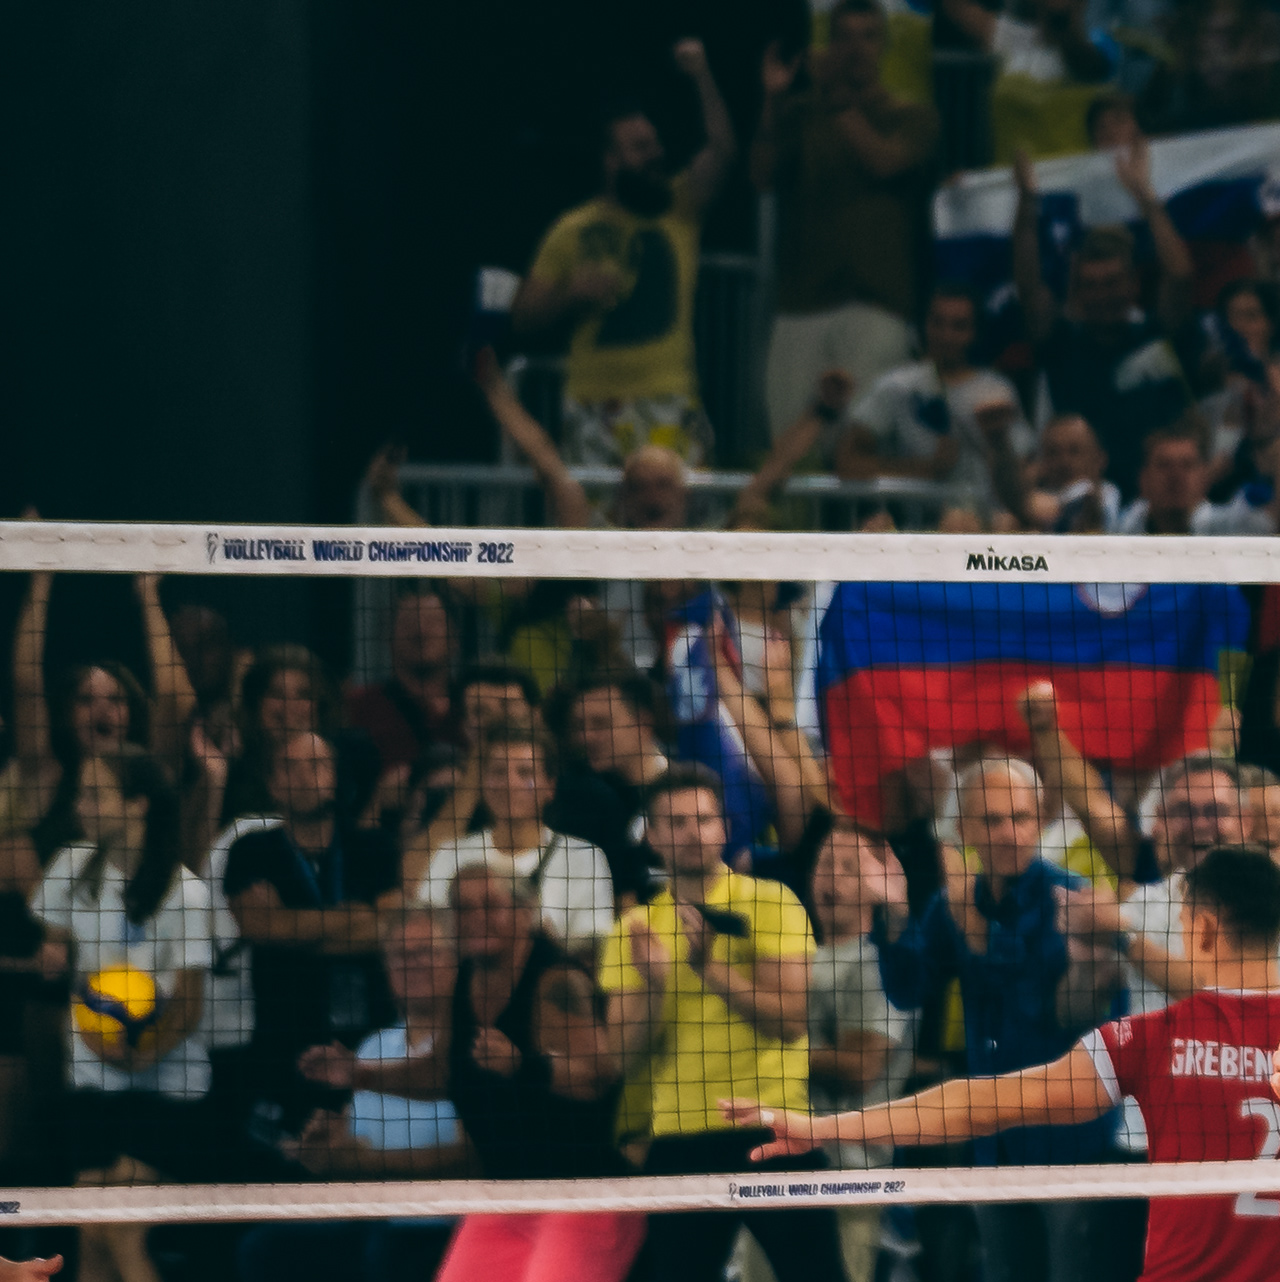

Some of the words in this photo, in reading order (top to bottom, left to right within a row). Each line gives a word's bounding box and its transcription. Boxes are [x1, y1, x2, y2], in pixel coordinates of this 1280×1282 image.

[223, 538, 306, 562] VOLLEYBALL
[312, 539, 365, 562] WORLD
[368, 540, 473, 563] CHAMPIONSHIP
[478, 542, 515, 564] 2022
[966, 549, 1049, 572] MIKASA
[739, 1184, 785, 1199] VOLLEYBALL
[788, 1183, 818, 1197] WORLD
[820, 1182, 881, 1196] CHAMPIONSHIP
[884, 1180, 906, 1194] 2022
